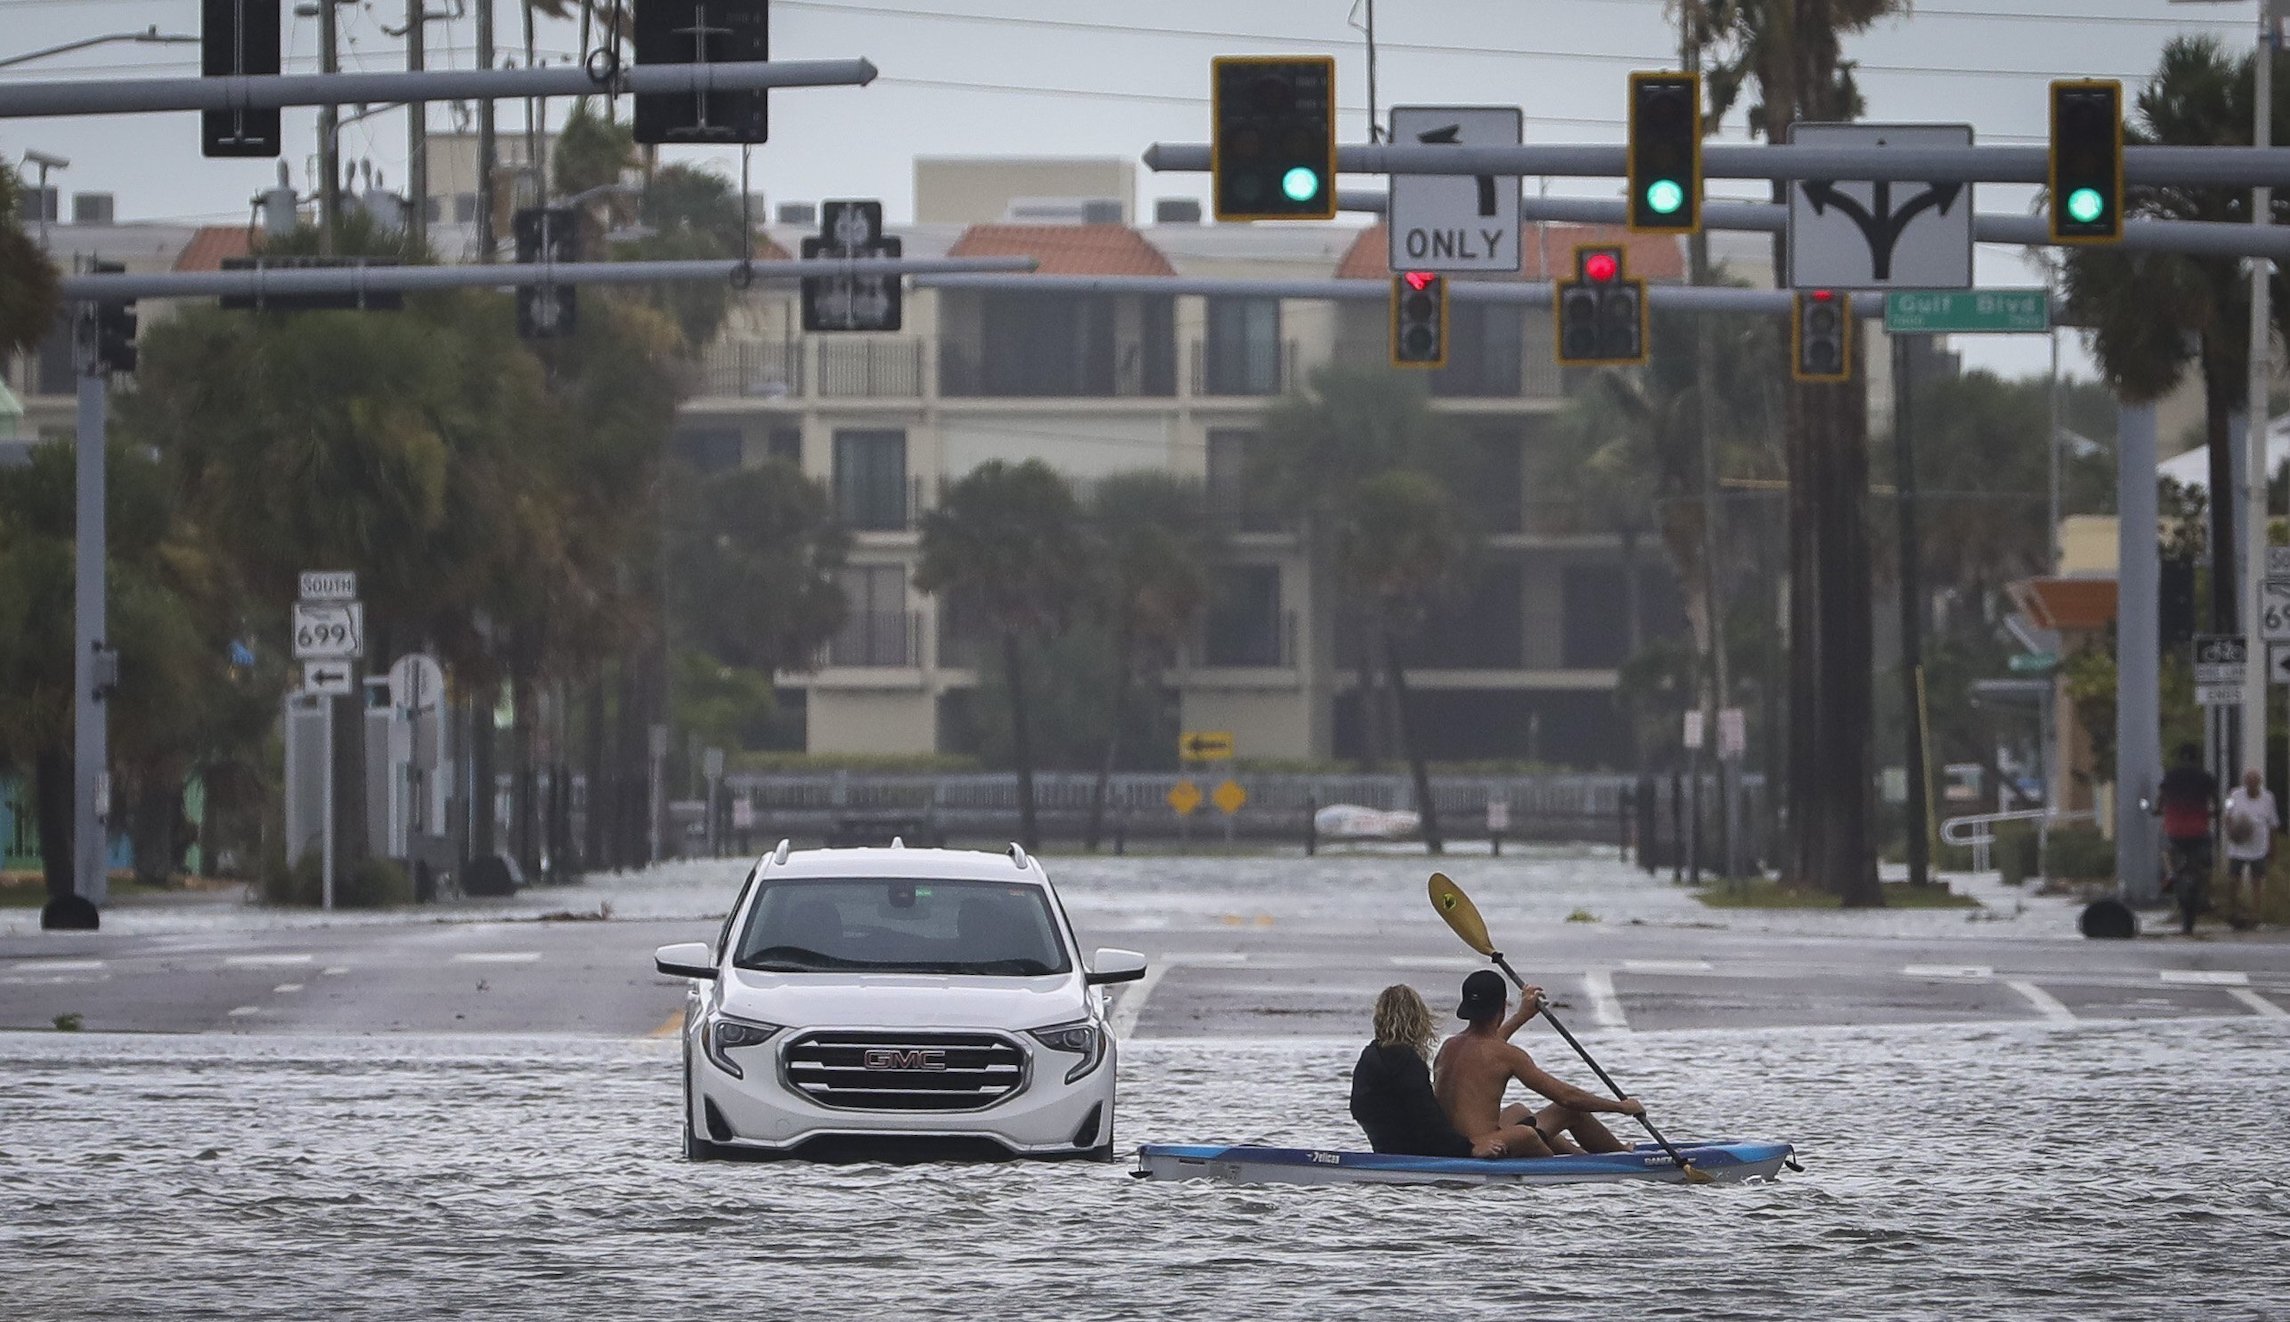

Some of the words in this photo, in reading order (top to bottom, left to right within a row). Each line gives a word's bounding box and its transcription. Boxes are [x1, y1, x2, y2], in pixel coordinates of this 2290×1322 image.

[1406, 228, 1504, 259] ONLY
[1898, 294, 1952, 314] Gulf
[1976, 293, 2035, 314] Blvd
[303, 578, 351, 593] SOUTH
[297, 623, 346, 648] 699
[864, 1049, 946, 1070] GMC
